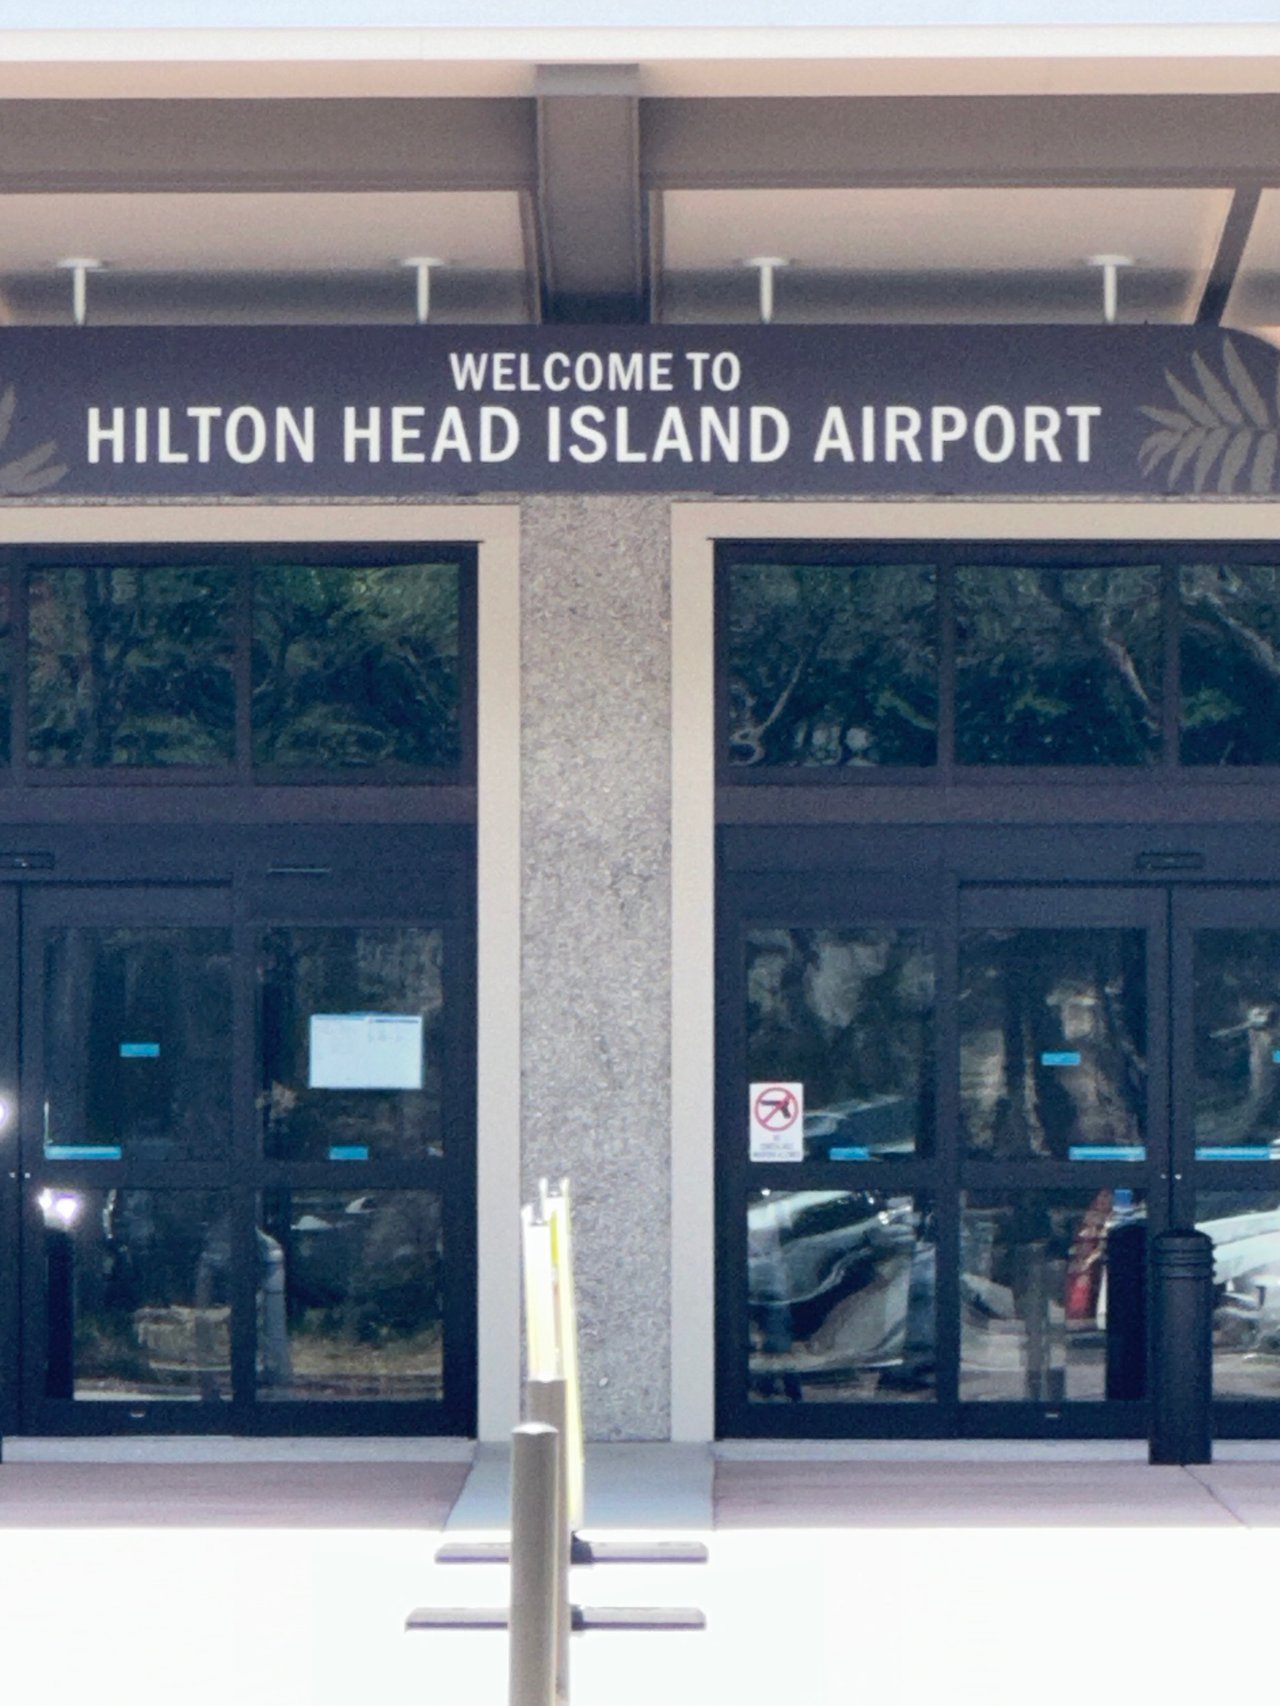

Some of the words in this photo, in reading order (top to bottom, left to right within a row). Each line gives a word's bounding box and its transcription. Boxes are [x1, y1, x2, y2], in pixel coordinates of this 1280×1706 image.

[449, 351, 674, 392] WELCOME
[685, 351, 741, 392] TO
[86, 405, 315, 465] HILTON
[343, 405, 520, 464] HEAD
[547, 404, 790, 464] ISLAND
[814, 404, 1102, 464] AIRPORT
